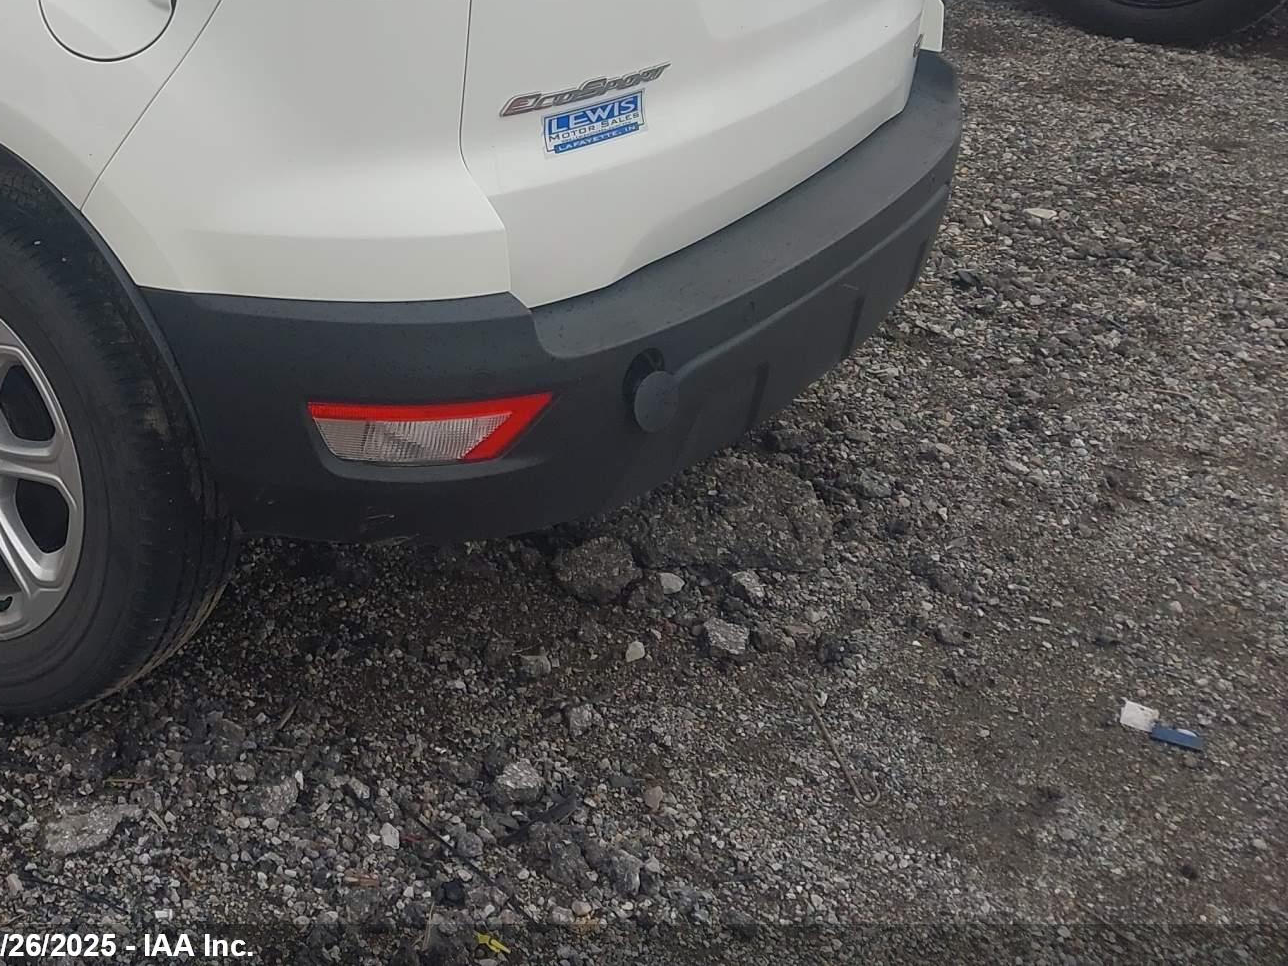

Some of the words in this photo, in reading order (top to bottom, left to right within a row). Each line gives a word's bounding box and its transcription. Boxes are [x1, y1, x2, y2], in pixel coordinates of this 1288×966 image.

[549, 126, 596, 143] MOTOR
[600, 112, 640, 128] SALES
[551, 97, 635, 134] LEWIS
